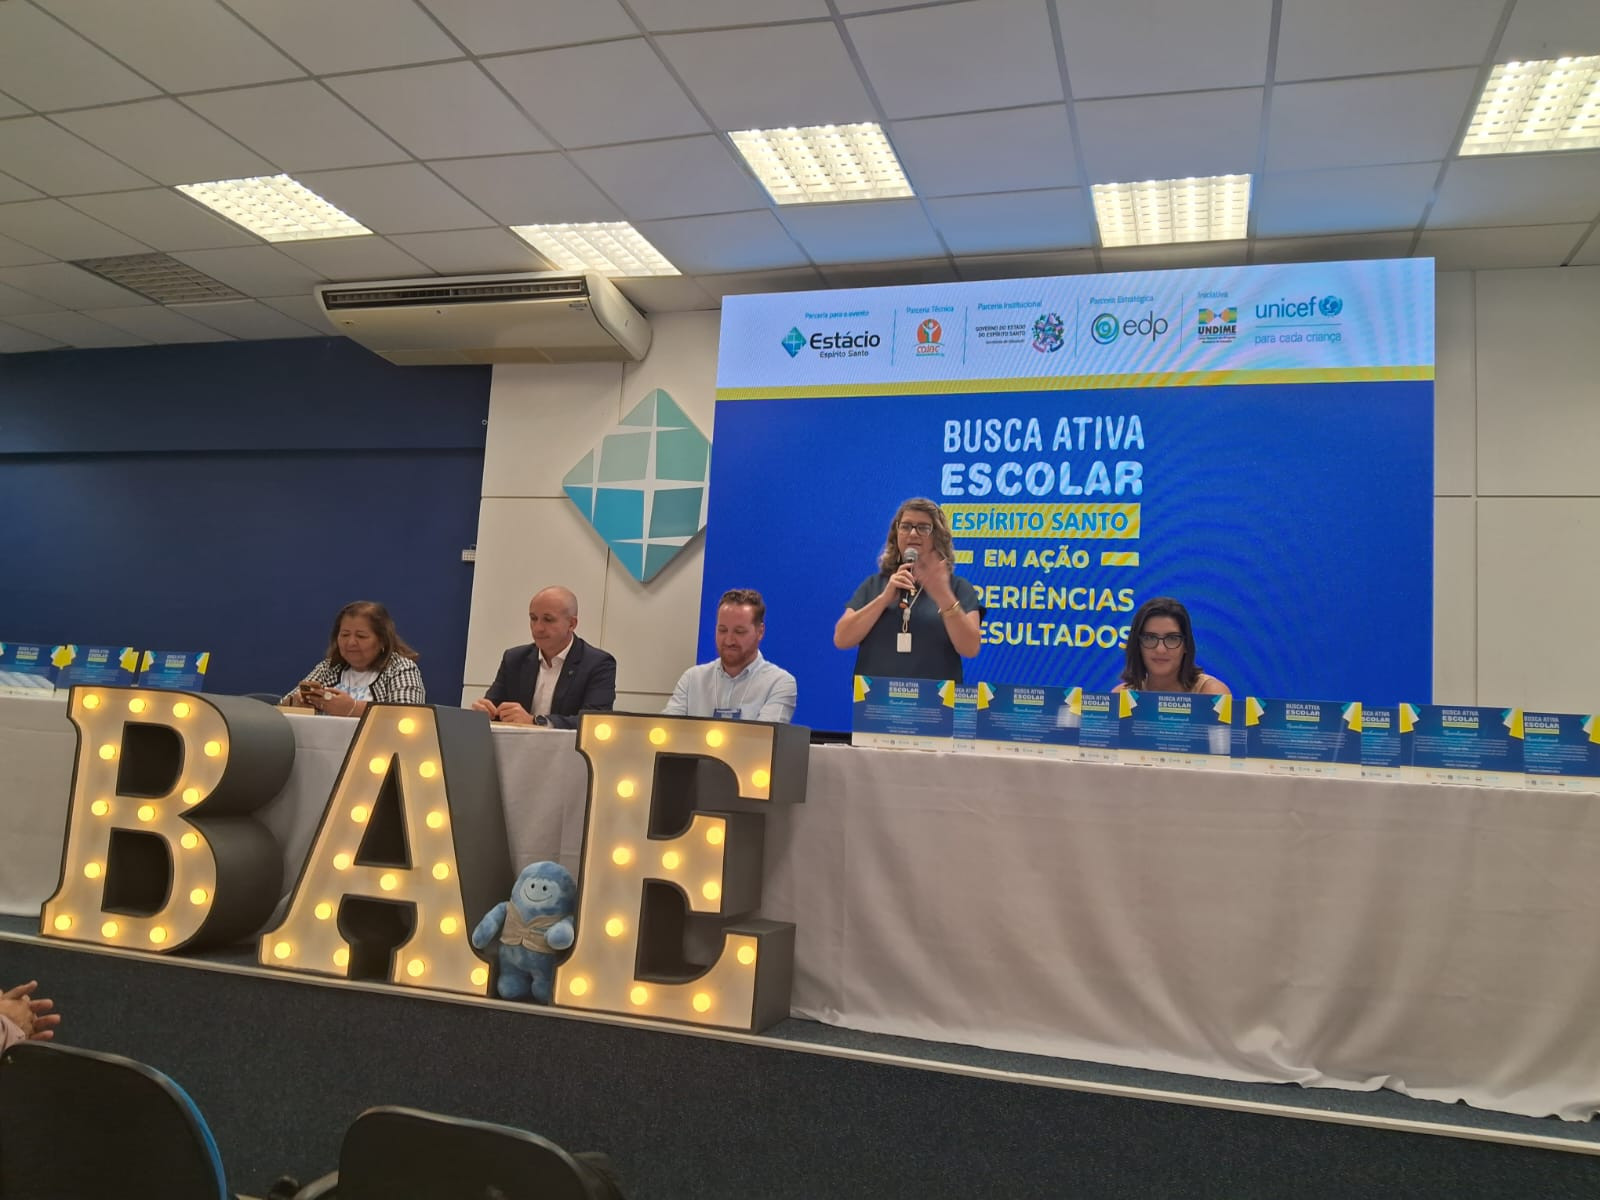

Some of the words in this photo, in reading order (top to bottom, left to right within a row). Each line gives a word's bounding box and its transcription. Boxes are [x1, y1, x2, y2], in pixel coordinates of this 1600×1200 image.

[1255, 296, 1317, 319] unicef
[1123, 310, 1168, 342] edp
[1198, 325, 1237, 334] UNDIME
[1255, 335, 1276, 345] para
[1279, 332, 1302, 342] cada
[1306, 332, 1342, 343] criança
[809, 330, 881, 350] Estácio
[943, 417, 1043, 453] BUSCA
[1052, 415, 1145, 451] ATIVA
[941, 460, 1143, 496] ESCOLAR
[952, 507, 1044, 531] ESPÍRITO
[1051, 512, 1128, 531] SANTO
[984, 549, 1017, 568] EM
[1023, 544, 1090, 574] AÇÃO
[979, 621, 1132, 648] ESULTADOS
[40, 684, 790, 1033] BAE
